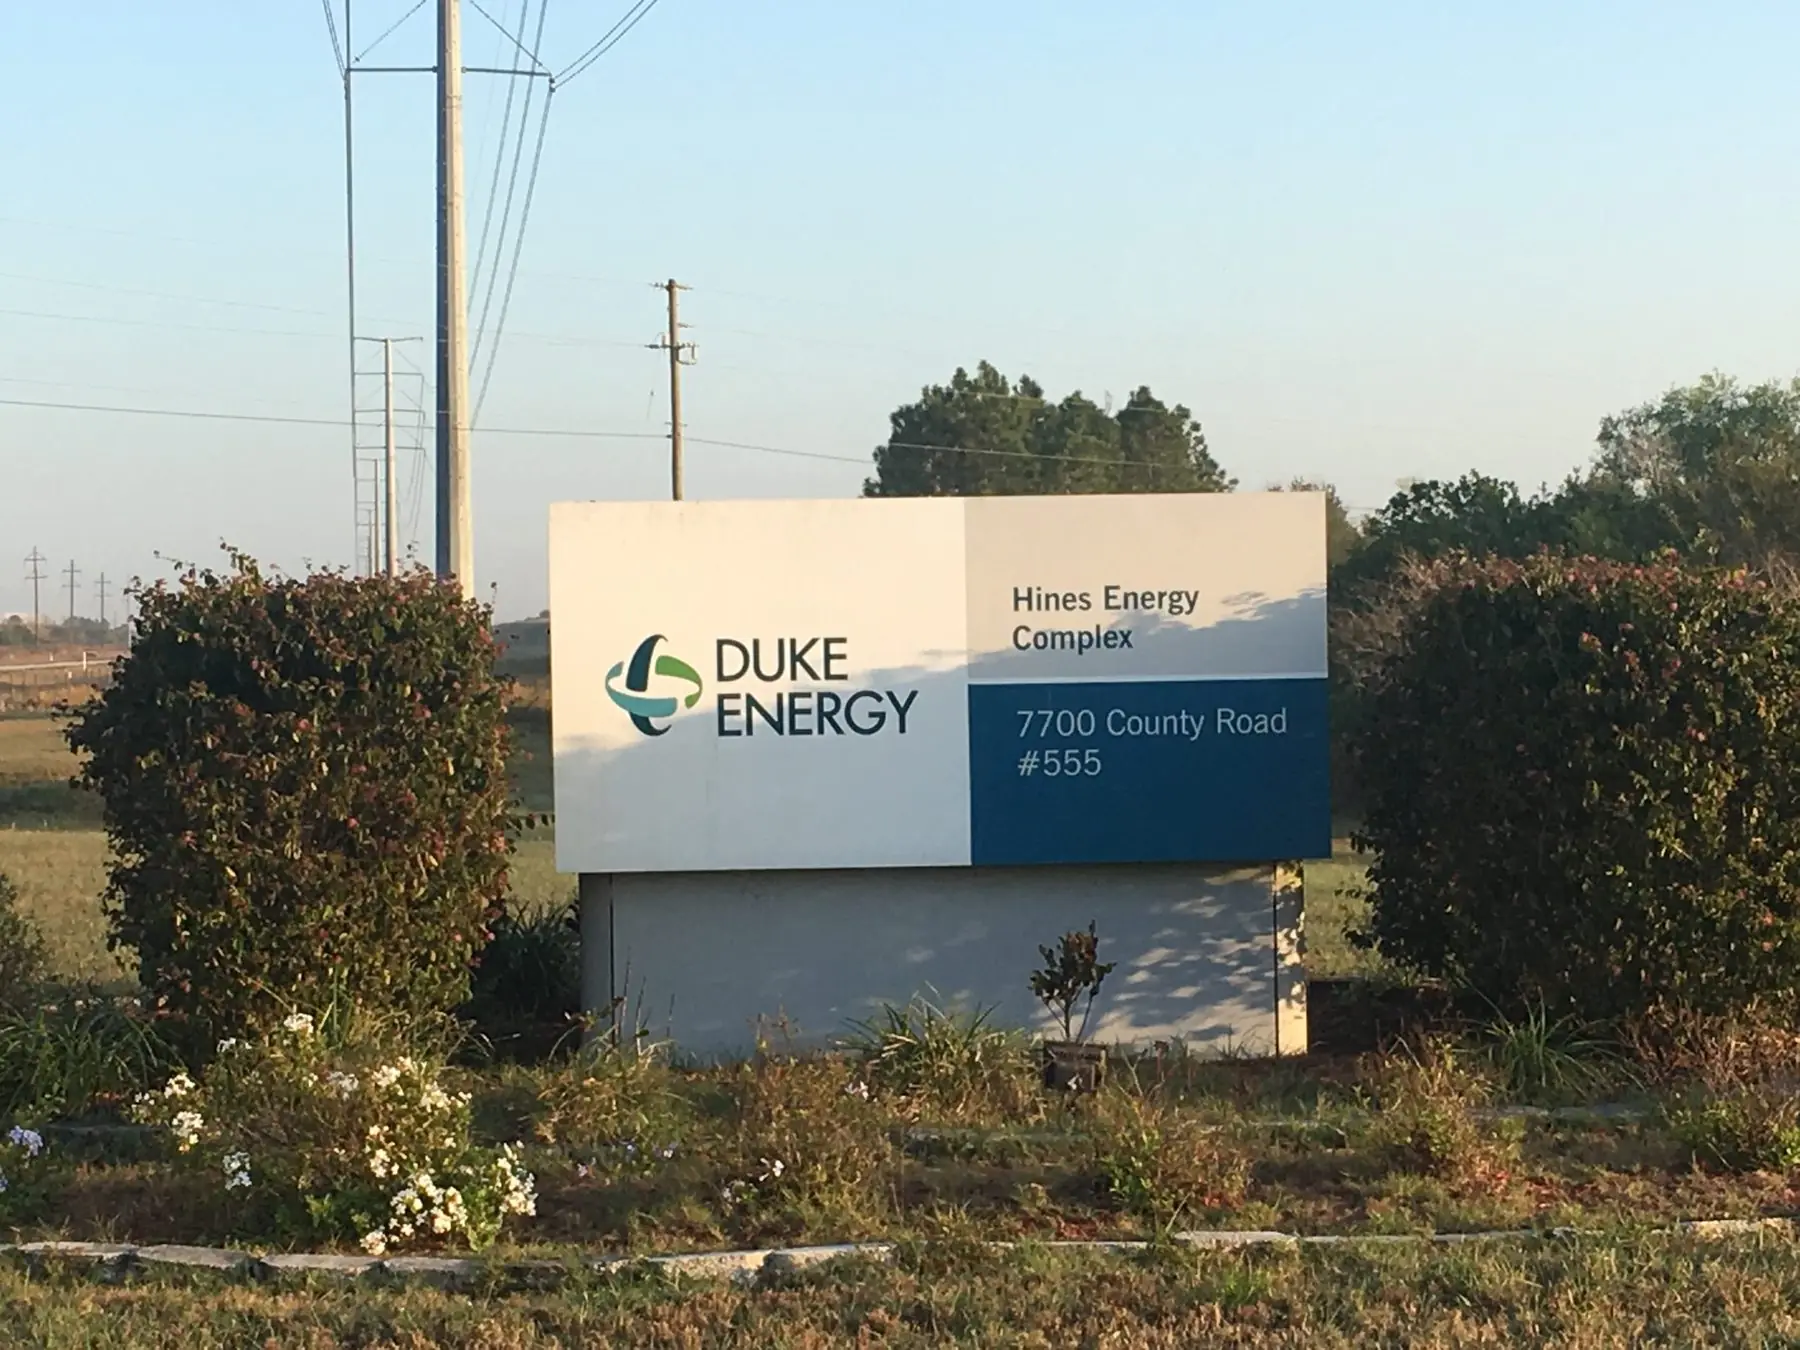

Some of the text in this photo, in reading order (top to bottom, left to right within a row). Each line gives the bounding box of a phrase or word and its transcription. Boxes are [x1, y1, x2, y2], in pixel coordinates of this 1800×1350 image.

[1012, 585, 1199, 615] Hines Energy
[1012, 624, 1134, 656] Complex
[716, 637, 848, 682] DUKE
[717, 690, 919, 737] ENERGY
[1017, 707, 1288, 741] 7700 County Road
[1017, 749, 1102, 777] #555
